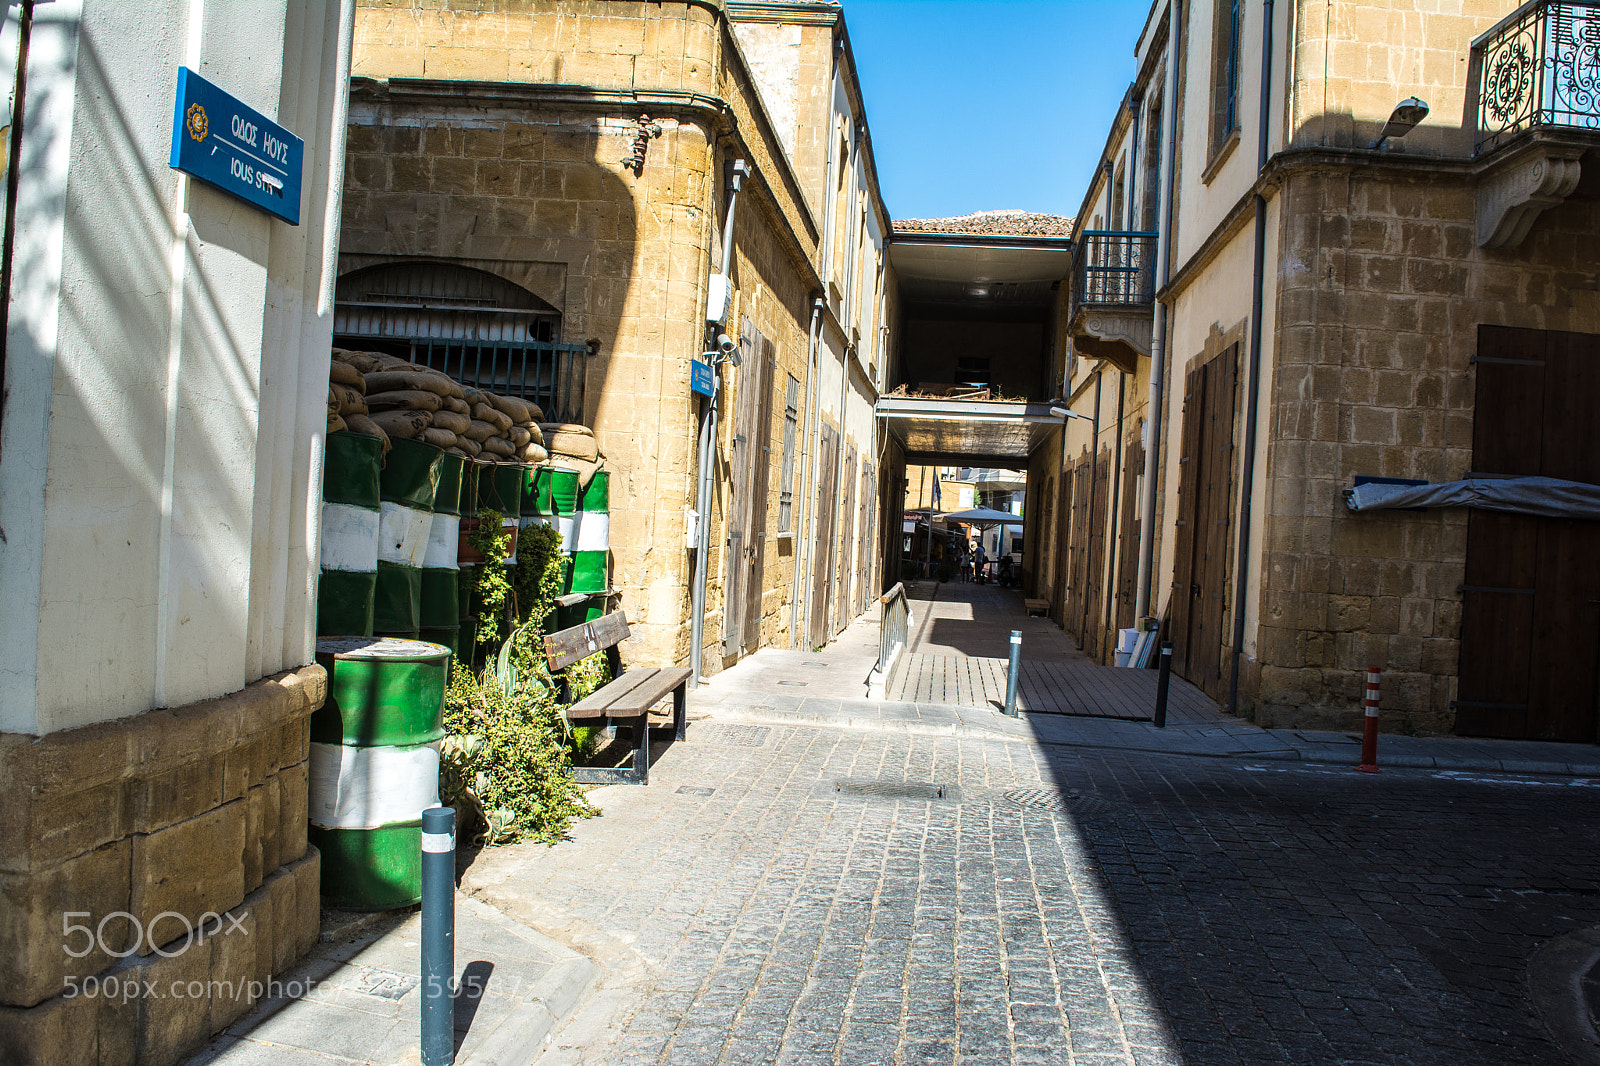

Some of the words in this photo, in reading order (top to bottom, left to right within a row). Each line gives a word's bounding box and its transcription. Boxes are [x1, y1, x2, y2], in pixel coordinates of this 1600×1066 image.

[231, 114, 258, 148] ΟΔΟΣ
[263, 131, 288, 165] ΗΟΥΣ
[230, 157, 254, 185] IOUS
